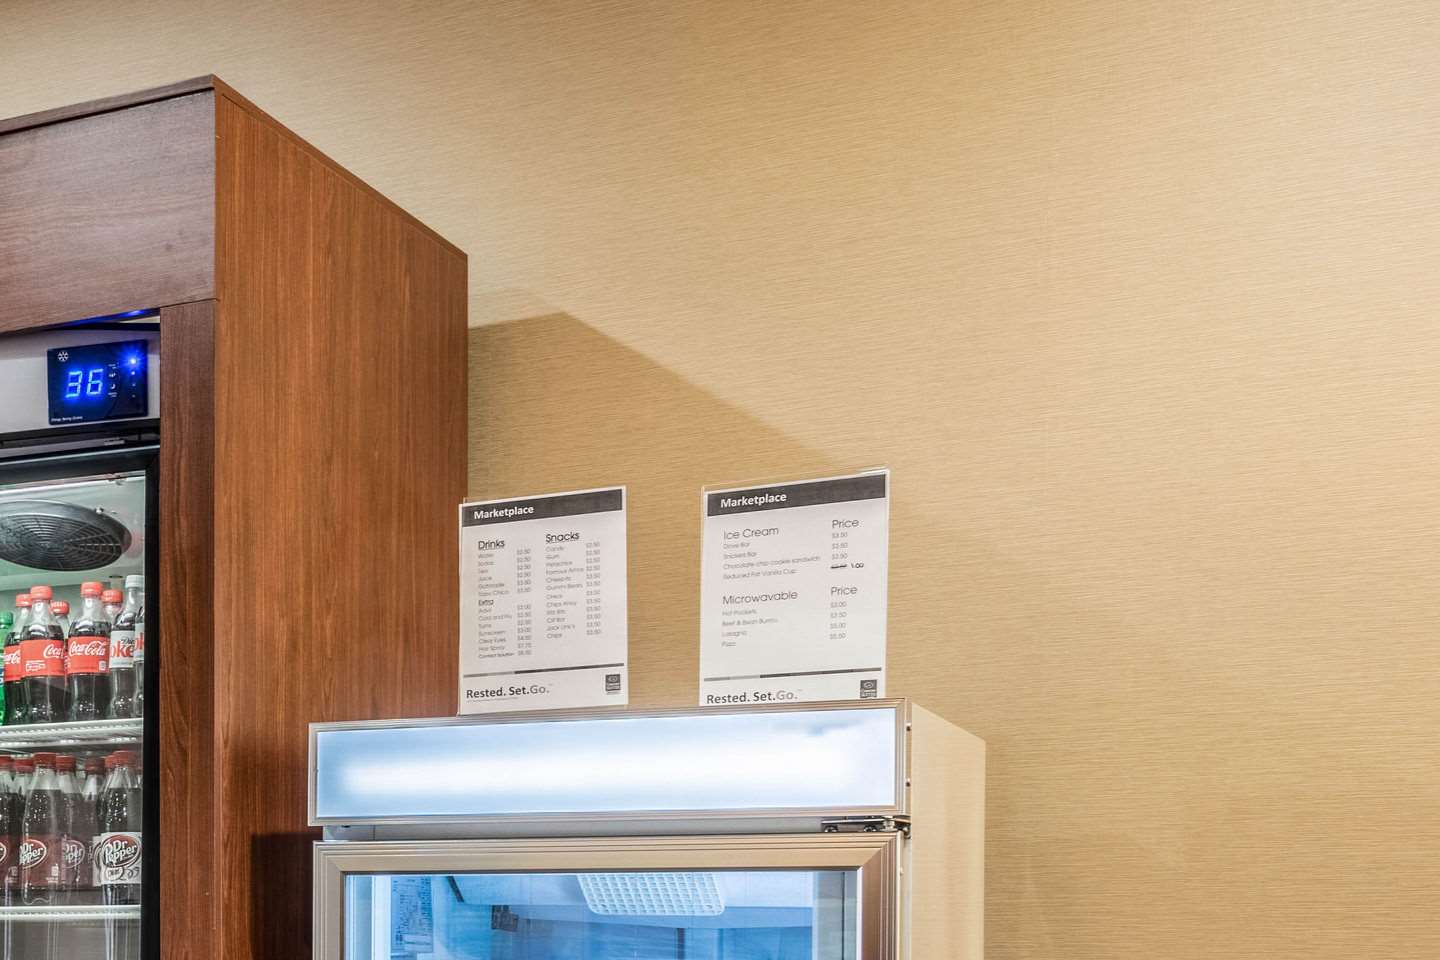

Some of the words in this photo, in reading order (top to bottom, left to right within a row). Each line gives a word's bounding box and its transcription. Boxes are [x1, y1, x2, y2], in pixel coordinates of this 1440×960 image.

[65, 368, 104, 399] 36
[720, 492, 788, 509] Marketplace
[473, 506, 535, 520] Marketplace
[831, 519, 860, 530] Price
[545, 532, 580, 543] Snacks
[723, 530, 740, 541] Ice
[742, 526, 780, 539] Cream
[478, 539, 506, 550] Drinks
[722, 590, 799, 605] Microwavable
[830, 586, 858, 597] Price
[68, 641, 108, 657] Coca-Cola
[466, 687, 507, 699] Rested.
[706, 691, 751, 704] Rested.
[113, 840, 128, 852] Dr
[105, 843, 137, 865] Pepper
